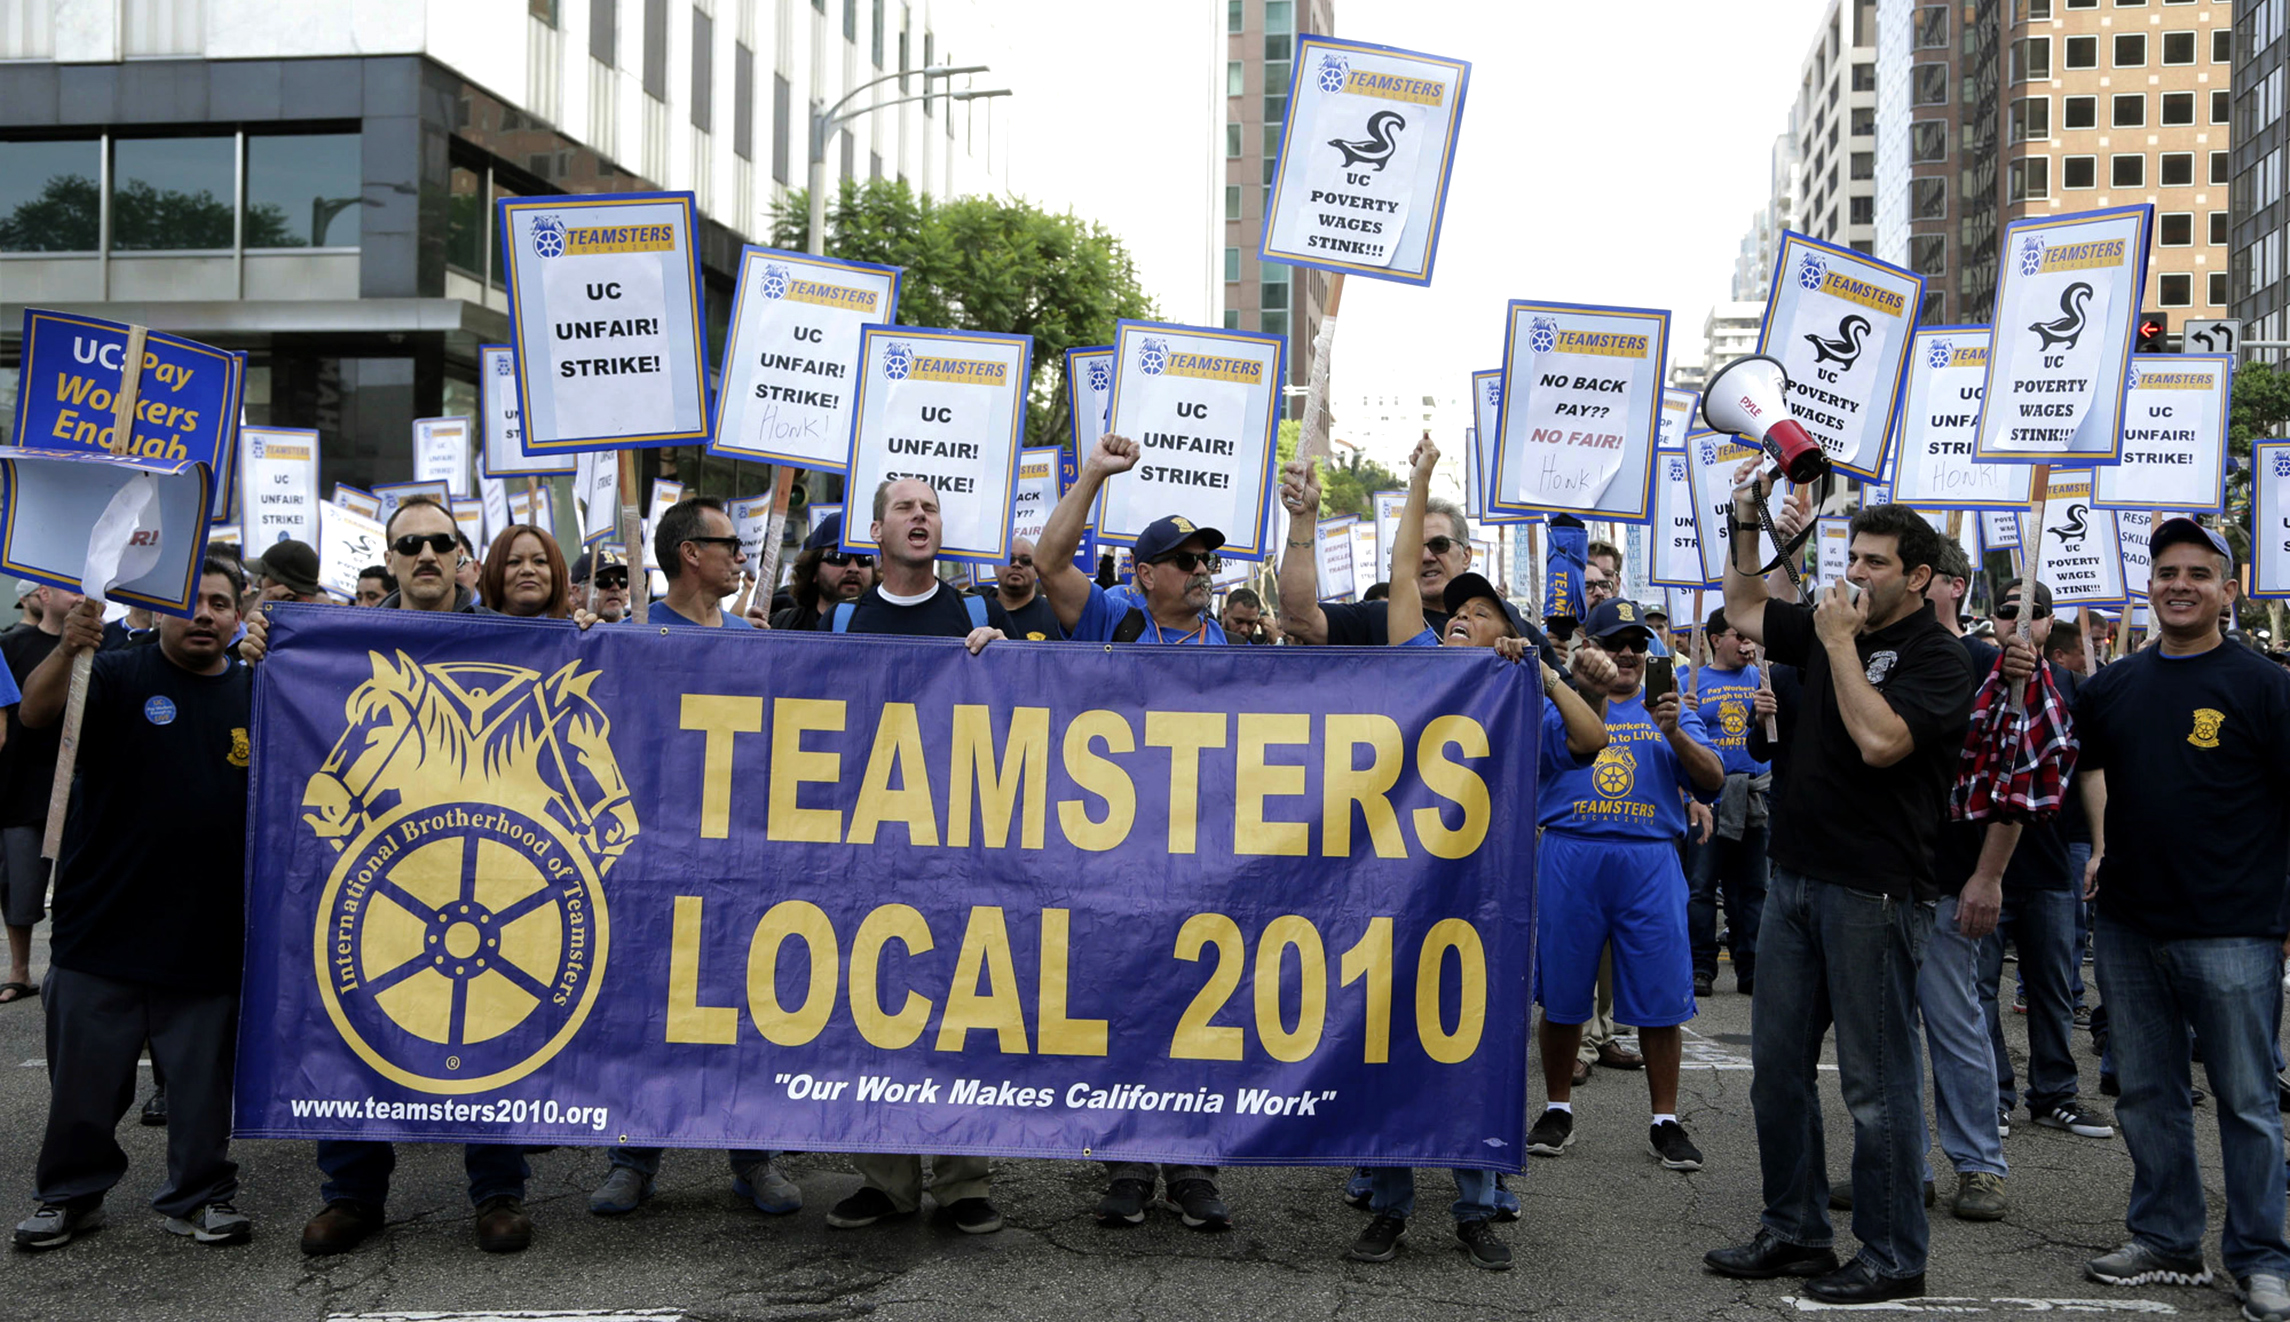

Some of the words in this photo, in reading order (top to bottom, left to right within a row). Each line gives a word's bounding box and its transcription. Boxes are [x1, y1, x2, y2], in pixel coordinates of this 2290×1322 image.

[1349, 71, 1443, 98] TEAMSTERS
[1346, 172, 1371, 187] UC
[1310, 190, 1399, 214] POVERTY
[1318, 213, 1383, 234] WAGES
[568, 226, 672, 245] TEAMSTERS
[1307, 235, 1384, 257] STINK!!!
[2044, 241, 2124, 264] TEAMSTERS
[586, 282, 622, 301] UC
[791, 280, 877, 305] TEAMSTERS
[1826, 272, 1904, 309] TEAMSTERS
[555, 318, 659, 340] UNFAIR!
[793, 326, 823, 343] UC
[1557, 331, 1647, 350] TEAMSTERS
[142, 350, 195, 393] Pay
[560, 356, 661, 378] STRIKE!
[759, 352, 846, 379] UNFAIR!
[913, 357, 1006, 378] TEAMSTERS
[1168, 353, 1261, 376] TEAMSTERS
[2044, 355, 2064, 369] UC
[1539, 374, 1569, 388] NO
[1572, 377, 1627, 394] BACK
[1817, 367, 1838, 384] UC
[2140, 373, 2213, 385] TEAMSTERS
[2013, 378, 2088, 393] POVERTY
[755, 384, 840, 410] STRIKE!
[1787, 379, 1860, 414] POVERTY
[921, 406, 952, 424] UC
[1176, 401, 1208, 420] UC
[1554, 403, 1610, 419] PAY??
[1790, 402, 1845, 431] WAGES
[2018, 403, 2074, 417] WAGES
[2149, 406, 2173, 418] UC
[1143, 432, 1234, 456] UNFAIR!
[1530, 428, 1563, 443] NO
[1567, 431, 1624, 450] FAIR!
[2124, 429, 2196, 441] UNFAIR!
[888, 437, 979, 460] UNFAIR!
[1928, 442, 1972, 455] STRI
[2123, 452, 2193, 464] STRIKE!
[1020, 463, 1049, 474] STERS
[1140, 465, 1230, 489] STRIKE!
[274, 474, 290, 484] UC
[1016, 491, 1040, 502] ACK
[2047, 483, 2091, 495] TEAMSTE
[260, 494, 303, 505] UNFAIR!
[262, 514, 304, 525] STRIKE!
[1016, 509, 1034, 519] Y??
[2123, 512, 2152, 526] RESP
[1324, 542, 1348, 553] RESPEC
[2065, 544, 2081, 552] UC
[2120, 531, 2150, 547] SKILL
[600, 550, 615, 564] B
[2047, 557, 2100, 568] POVERTY
[2056, 571, 2096, 581] WAGES
[2055, 584, 2101, 595] STINK!!!
[1701, 693, 1733, 704] Enough
[1744, 691, 1756, 699] LIV
[1604, 722, 1652, 732] Workers
[1618, 734, 1631, 743] to
[1633, 730, 1662, 743] LIVE
[679, 693, 1491, 860] TEAMSTERS
[1572, 800, 1656, 818] TEAMSTERS
[400, 807, 552, 858] Brotherhood
[547, 856, 573, 880] of
[336, 834, 400, 996] International
[552, 880, 586, 1007] Teamsters
[665, 895, 1108, 1057] LOCAL
[1169, 912, 1487, 1065] 2010
[774, 1072, 848, 1101] "Our
[855, 1075, 940, 1105] Work
[947, 1078, 1055, 1110] Makes
[1064, 1080, 1224, 1115] California
[1235, 1086, 1337, 1117] Work"
[291, 1096, 608, 1130] www.teamsters2010.org
